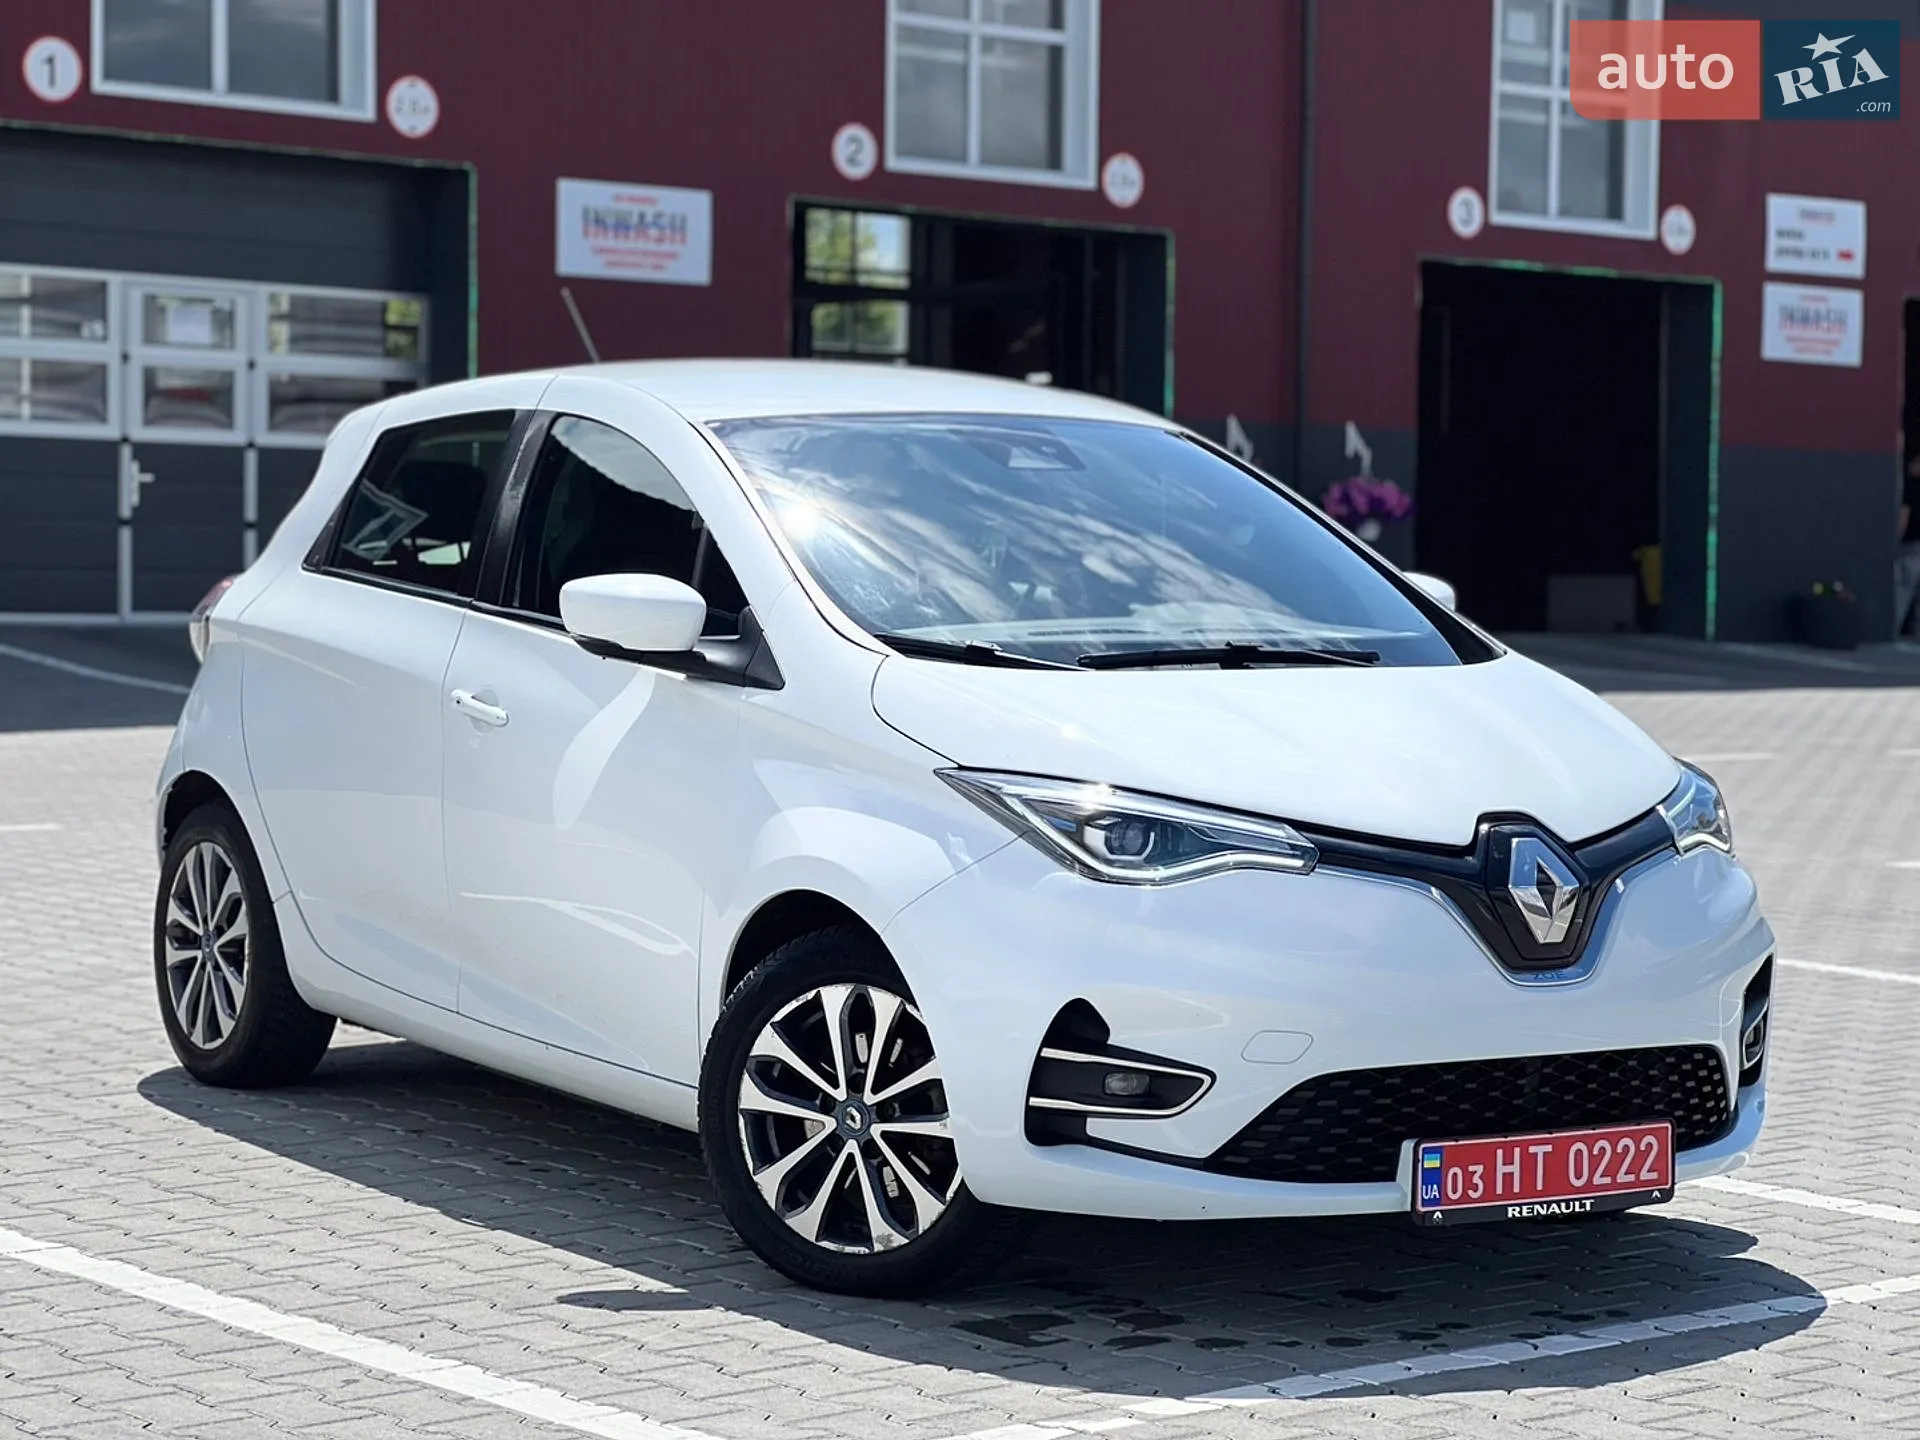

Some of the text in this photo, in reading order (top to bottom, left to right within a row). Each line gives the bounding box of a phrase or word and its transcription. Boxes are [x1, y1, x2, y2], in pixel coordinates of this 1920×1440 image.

[41, 54, 56, 88] 1
[845, 136, 865, 168] 2
[581, 204, 688, 246] INWASH
[1458, 197, 1475, 229] 3
[1446, 1134, 1660, 1200] 03 HT 0222
[1422, 1184, 1440, 1200] UA
[1507, 1199, 1595, 1218] RENAULT
